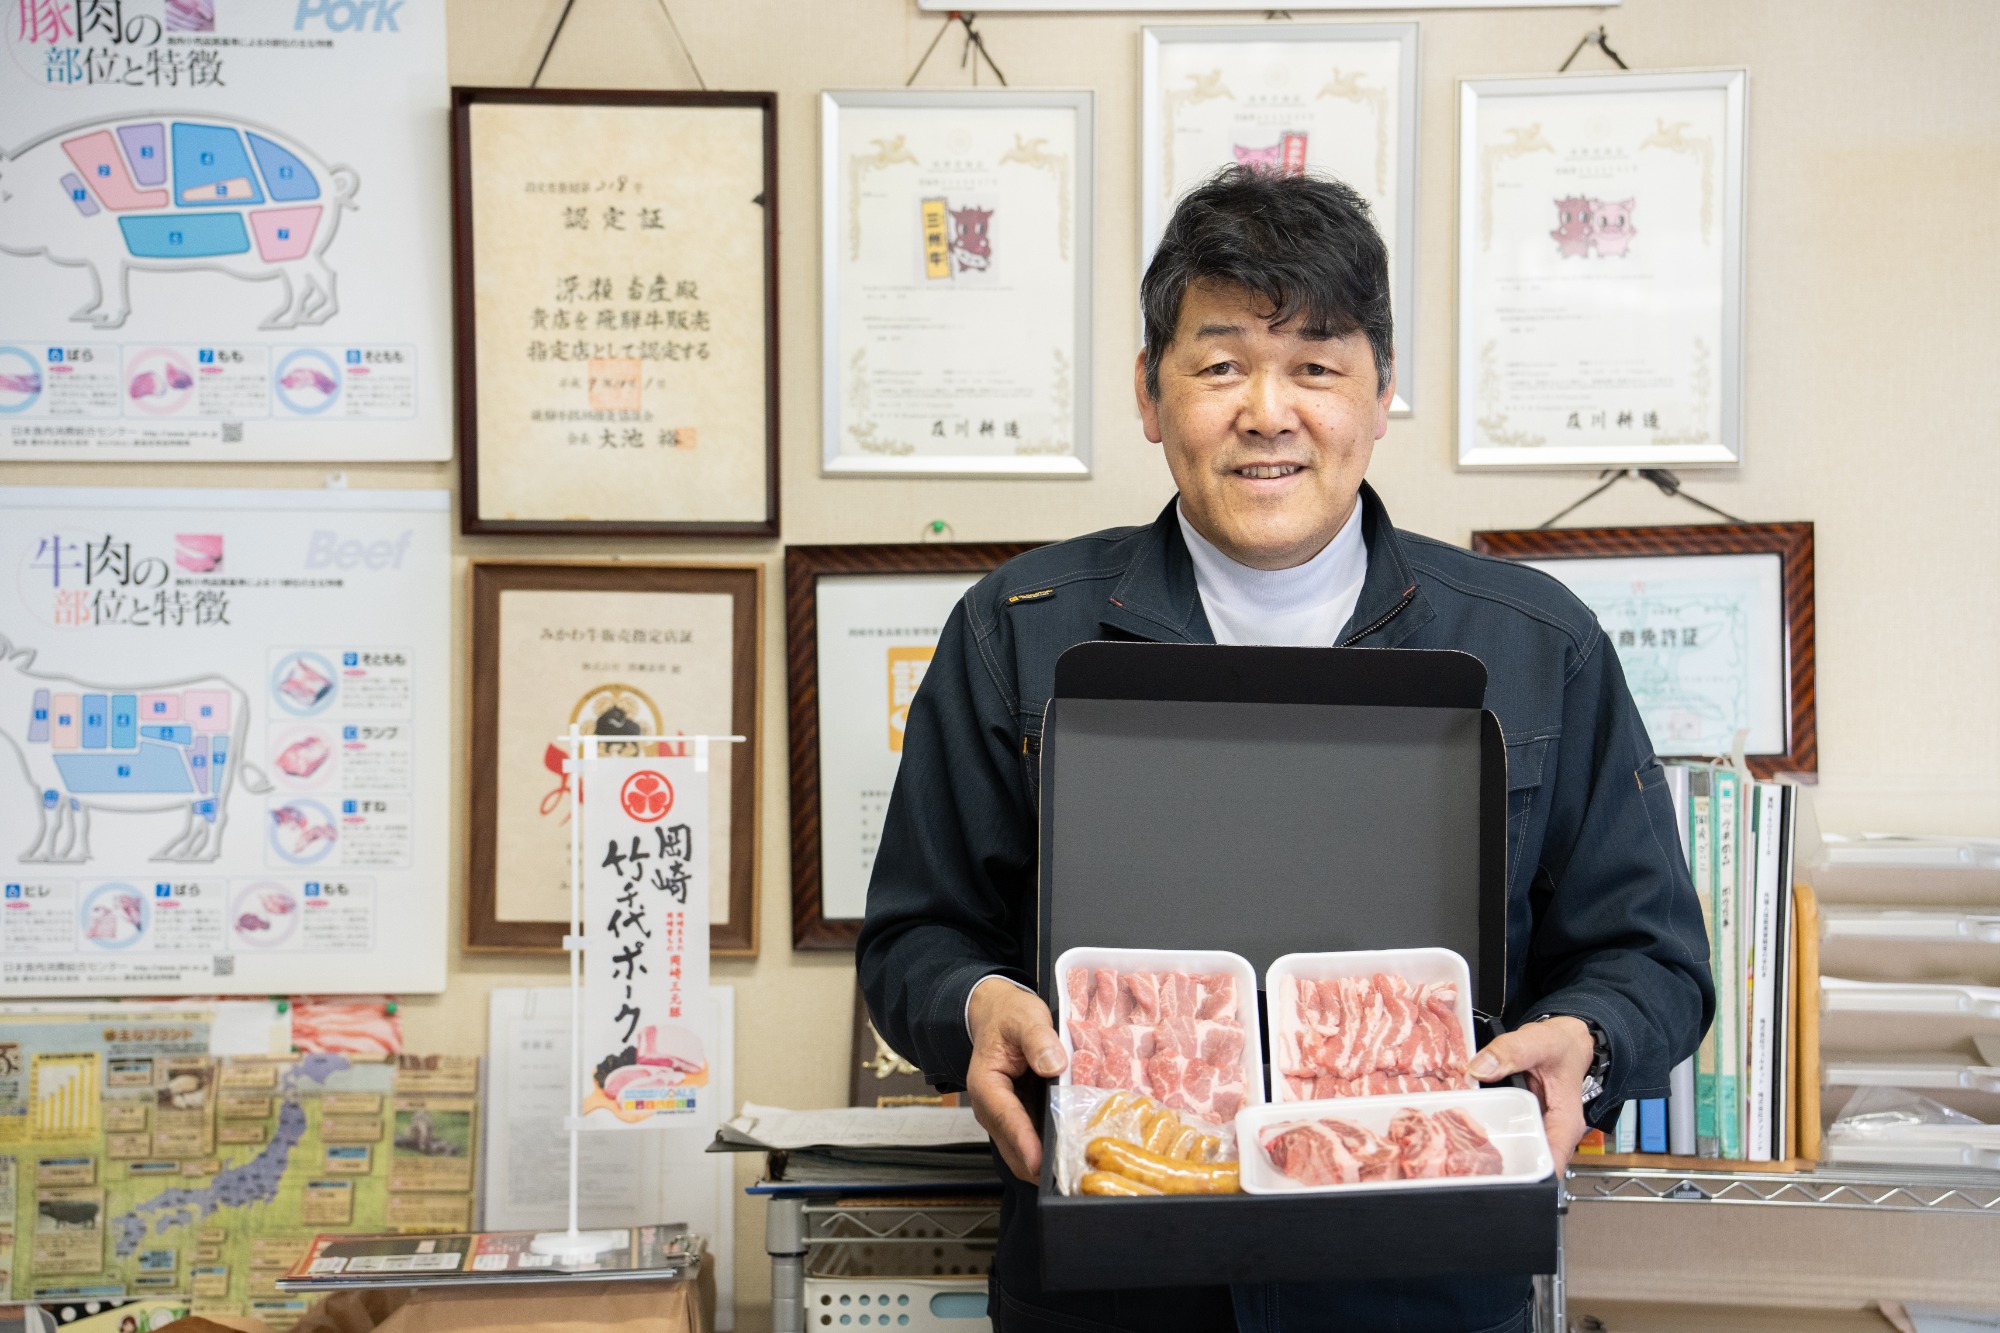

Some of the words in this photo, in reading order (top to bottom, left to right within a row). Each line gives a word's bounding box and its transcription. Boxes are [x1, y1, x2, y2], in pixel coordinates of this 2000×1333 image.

[18, 0, 162, 46] 豚肉の
[294, 0, 406, 32] Pork
[43, 46, 226, 88] 部位と特徴
[562, 206, 665, 231] 認定証
[67, 348, 94, 362] ばら
[218, 350, 244, 363] もも
[527, 339, 710, 362] 指定店として認定する
[30, 534, 170, 589] 牛肉の
[305, 529, 413, 571] Beef
[54, 589, 231, 627] 部位と特徴
[1607, 627, 1698, 647] 商免許証
[361, 800, 387, 813] すね
[651, 823, 692, 904] 岡崎
[24, 884, 50, 898] ヒレ
[174, 884, 201, 897] ばら
[323, 883, 349, 897] もも
[602, 836, 651, 1043] 竹千代ポーク
